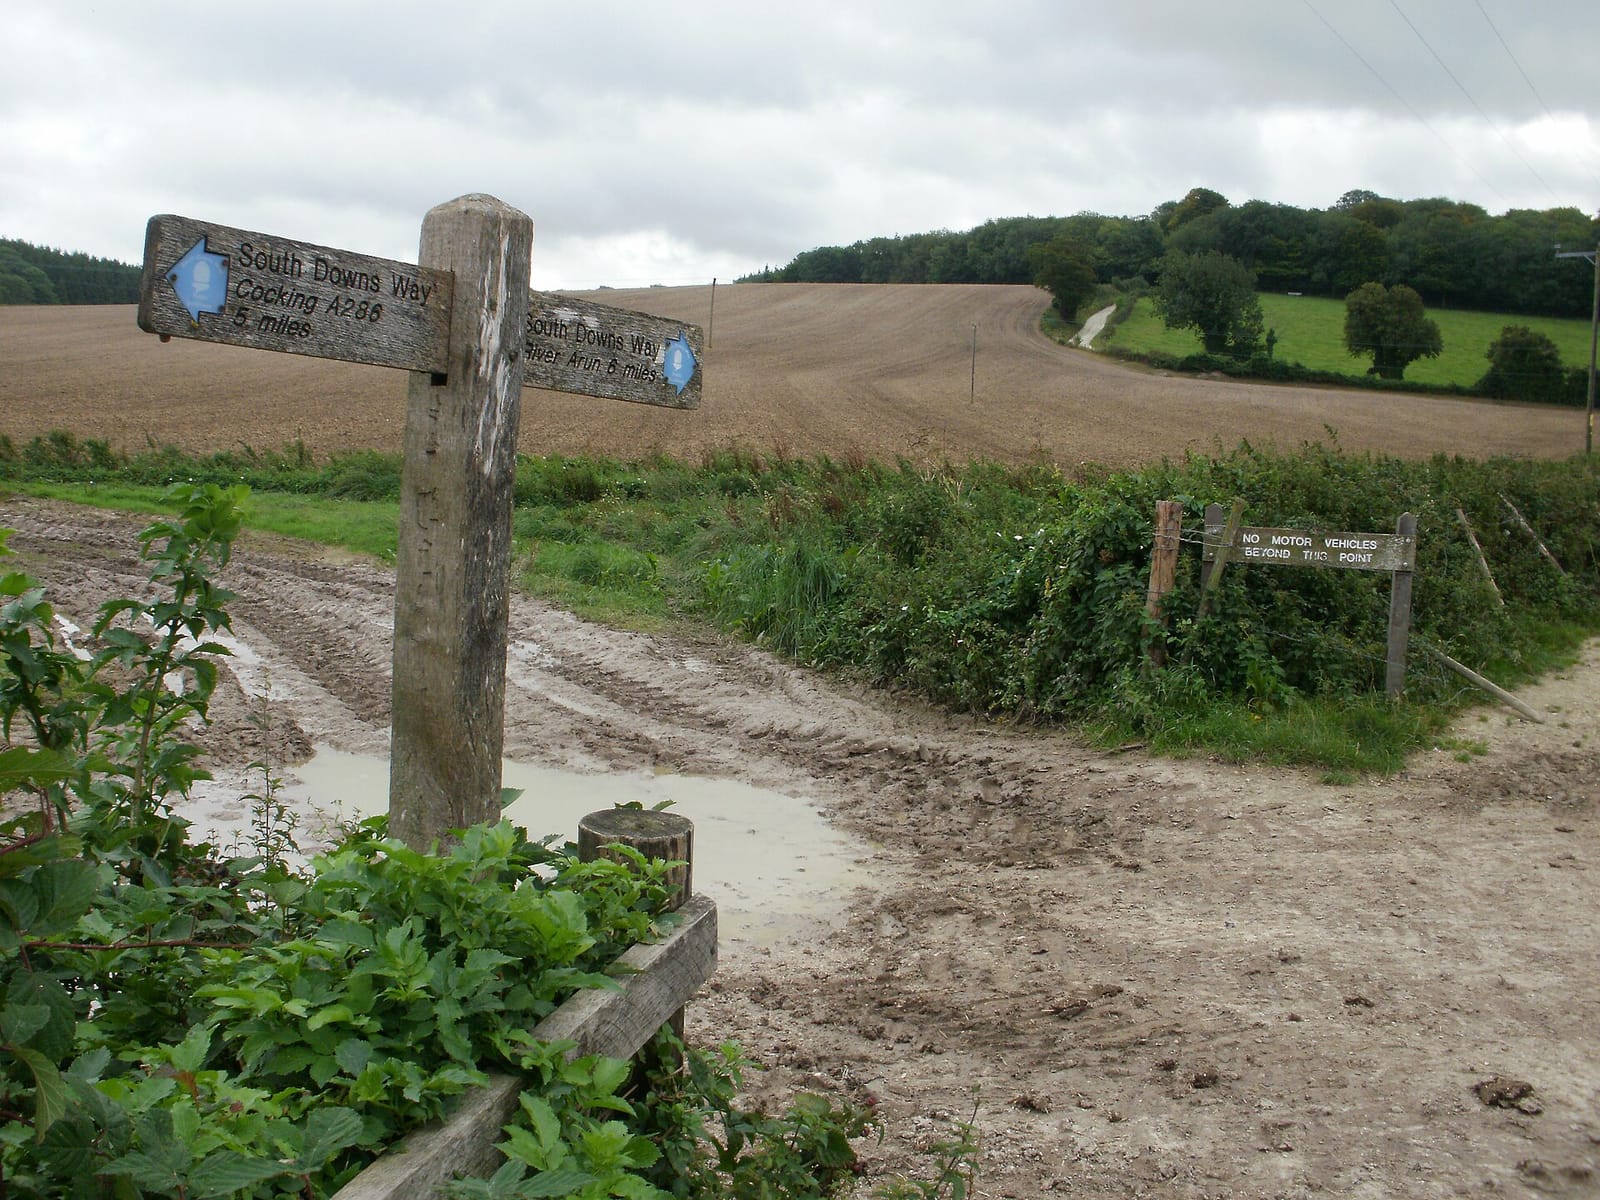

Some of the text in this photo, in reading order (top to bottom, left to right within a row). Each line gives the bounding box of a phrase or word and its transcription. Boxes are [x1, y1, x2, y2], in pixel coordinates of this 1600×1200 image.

[238, 242, 303, 279] South
[313, 257, 381, 293] Downs
[391, 273, 432, 307] Way
[235, 279, 383, 323] Cocking A286
[232, 306, 313, 338] 5 miles
[576, 323, 624, 351] Downs
[631, 334, 661, 362] Way
[566, 351, 601, 373] Arun
[607, 358, 618, 375] 6
[622, 363, 657, 382] miles
[1242, 533, 1377, 550] NO MOTOR VEHICLES
[1245, 547, 1291, 559] BEYOND
[1339, 552, 1373, 563] POINT
